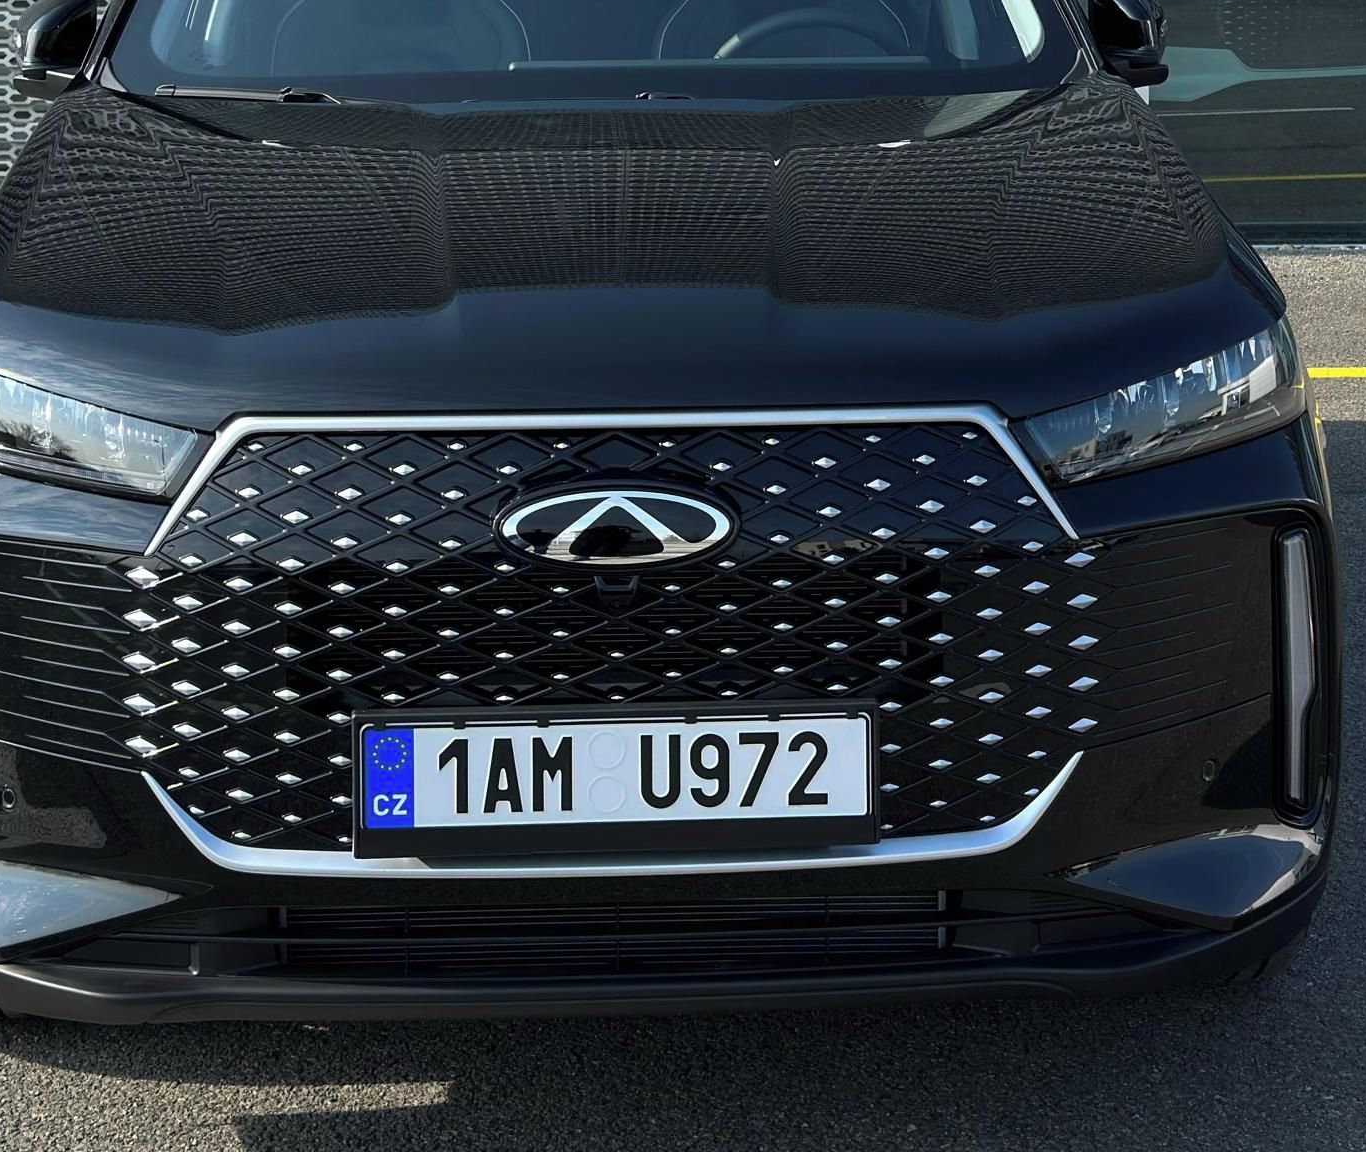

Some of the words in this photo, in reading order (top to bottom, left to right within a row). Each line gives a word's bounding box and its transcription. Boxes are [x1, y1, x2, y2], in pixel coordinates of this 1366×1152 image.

[438, 736, 573, 814] 1AM
[640, 730, 829, 808] U972
[374, 794, 408, 816] CZ
